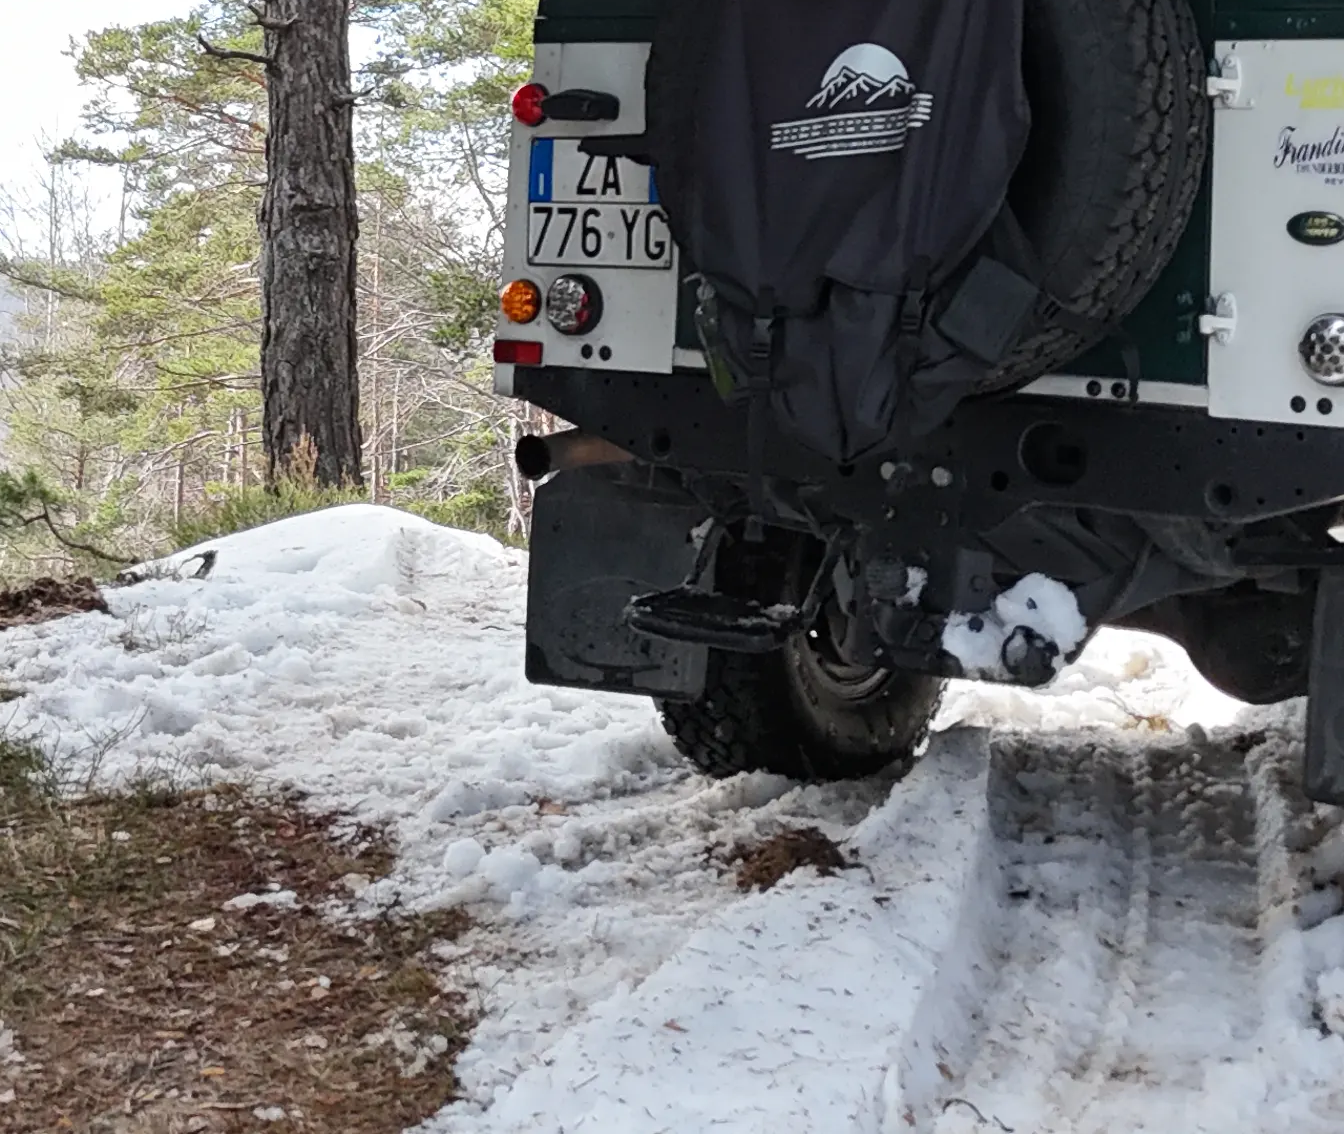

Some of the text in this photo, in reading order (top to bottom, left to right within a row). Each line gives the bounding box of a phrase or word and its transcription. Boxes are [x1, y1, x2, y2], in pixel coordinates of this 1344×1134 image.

[576, 155, 622, 196] ZA
[533, 207, 669, 260] 776 YG
